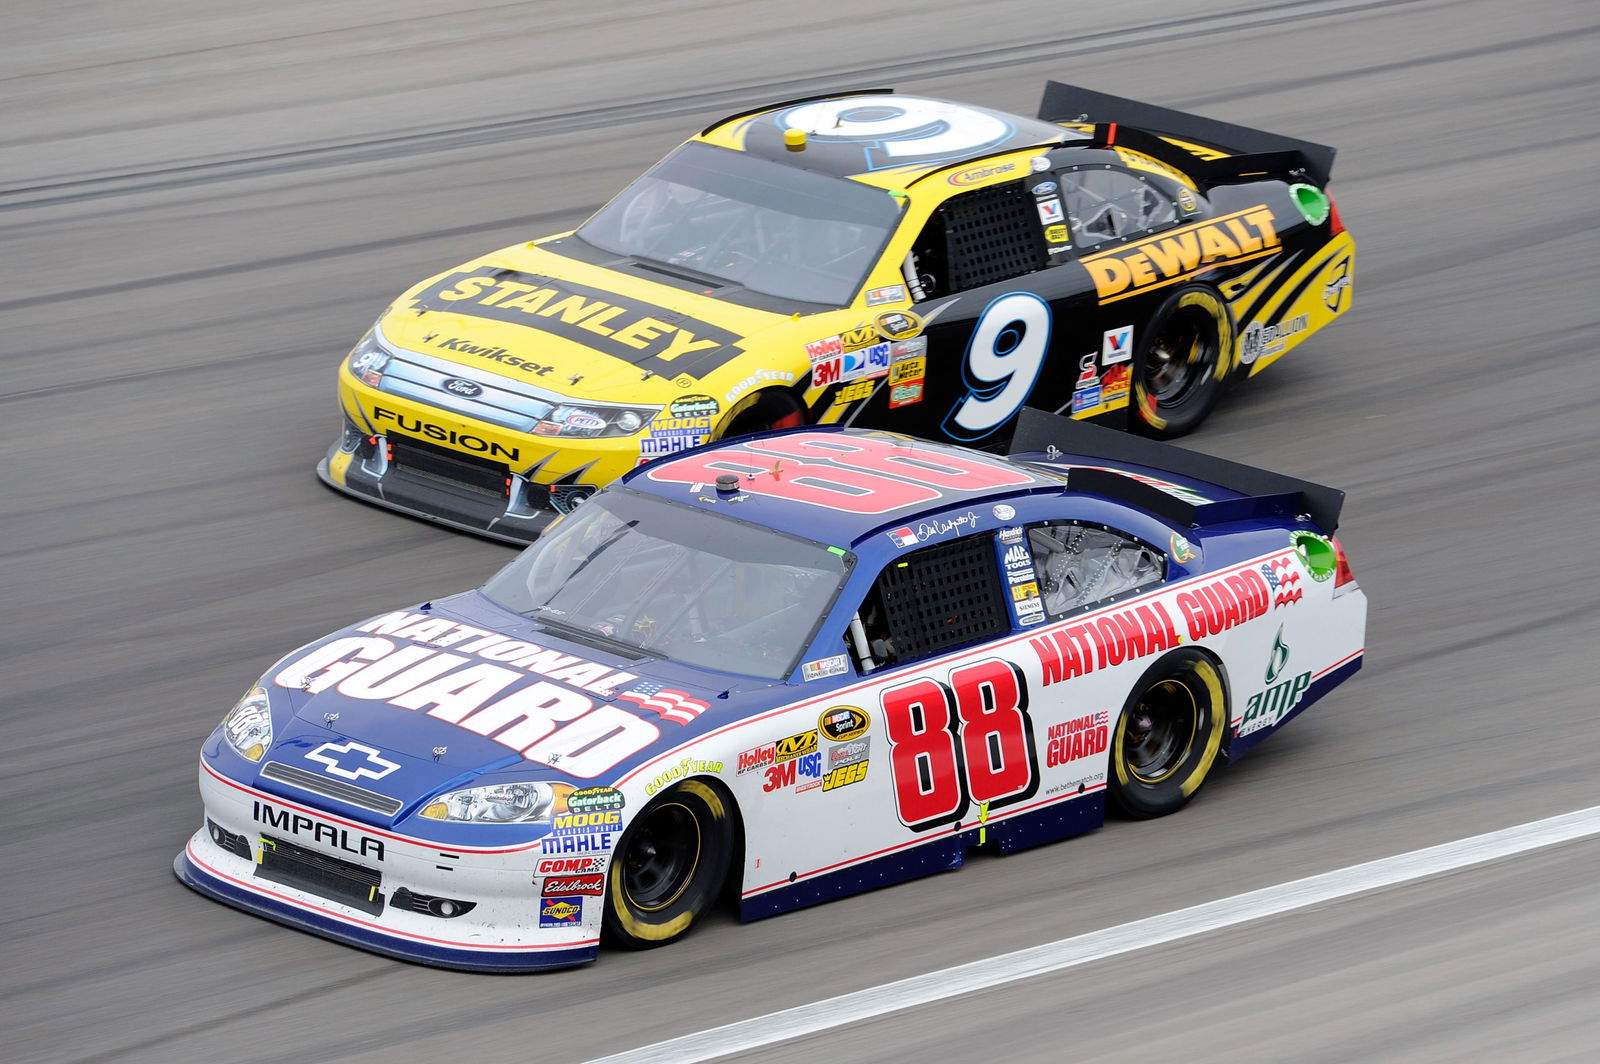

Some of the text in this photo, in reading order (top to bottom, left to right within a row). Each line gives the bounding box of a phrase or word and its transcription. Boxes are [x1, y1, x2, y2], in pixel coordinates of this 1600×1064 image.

[776, 93, 1018, 171] 9
[964, 163, 1016, 182] Ambrose
[1082, 212, 1281, 299] DEWALT
[439, 276, 721, 362] STANLEY
[437, 337, 556, 378] Kwikset
[942, 291, 1053, 441] 9
[725, 369, 794, 402] GOODYEAR
[814, 359, 840, 387] 3M
[448, 380, 478, 395] Ford
[836, 380, 876, 404] JEGS
[373, 406, 519, 461] FUSION
[651, 416, 710, 432] MOOG
[1004, 545, 1030, 564] MAC
[1005, 559, 1032, 570] TOOLS
[1019, 602, 1040, 611] SIEMENS
[1029, 568, 1269, 687] NATIONAL GUARD
[355, 610, 642, 698] NATIONAL
[273, 636, 661, 779] GUARD
[1241, 671, 1312, 728] amp
[836, 719, 854, 733] Sprint
[1048, 714, 1094, 741] NATIONAL
[880, 657, 1041, 832] 88
[1046, 725, 1108, 768] GUARD
[739, 747, 775, 770] Holley
[799, 752, 821, 778] USG
[645, 757, 723, 796] GOODYEAR
[763, 760, 796, 792] 3M
[822, 759, 870, 792] JEGS
[568, 793, 621, 807] Gatorback
[573, 787, 613, 797] GOODYEAR
[553, 811, 620, 830] MOOG
[573, 802, 620, 813] BELTS
[253, 801, 385, 861] IMPALA
[556, 823, 620, 837] CHASSIS PARTS
[541, 833, 611, 854] MAHLE
[539, 858, 593, 873] COMP
[575, 866, 600, 874] CAMS
[544, 879, 602, 893] Edelbrock
[544, 906, 579, 915] SUNOCO
